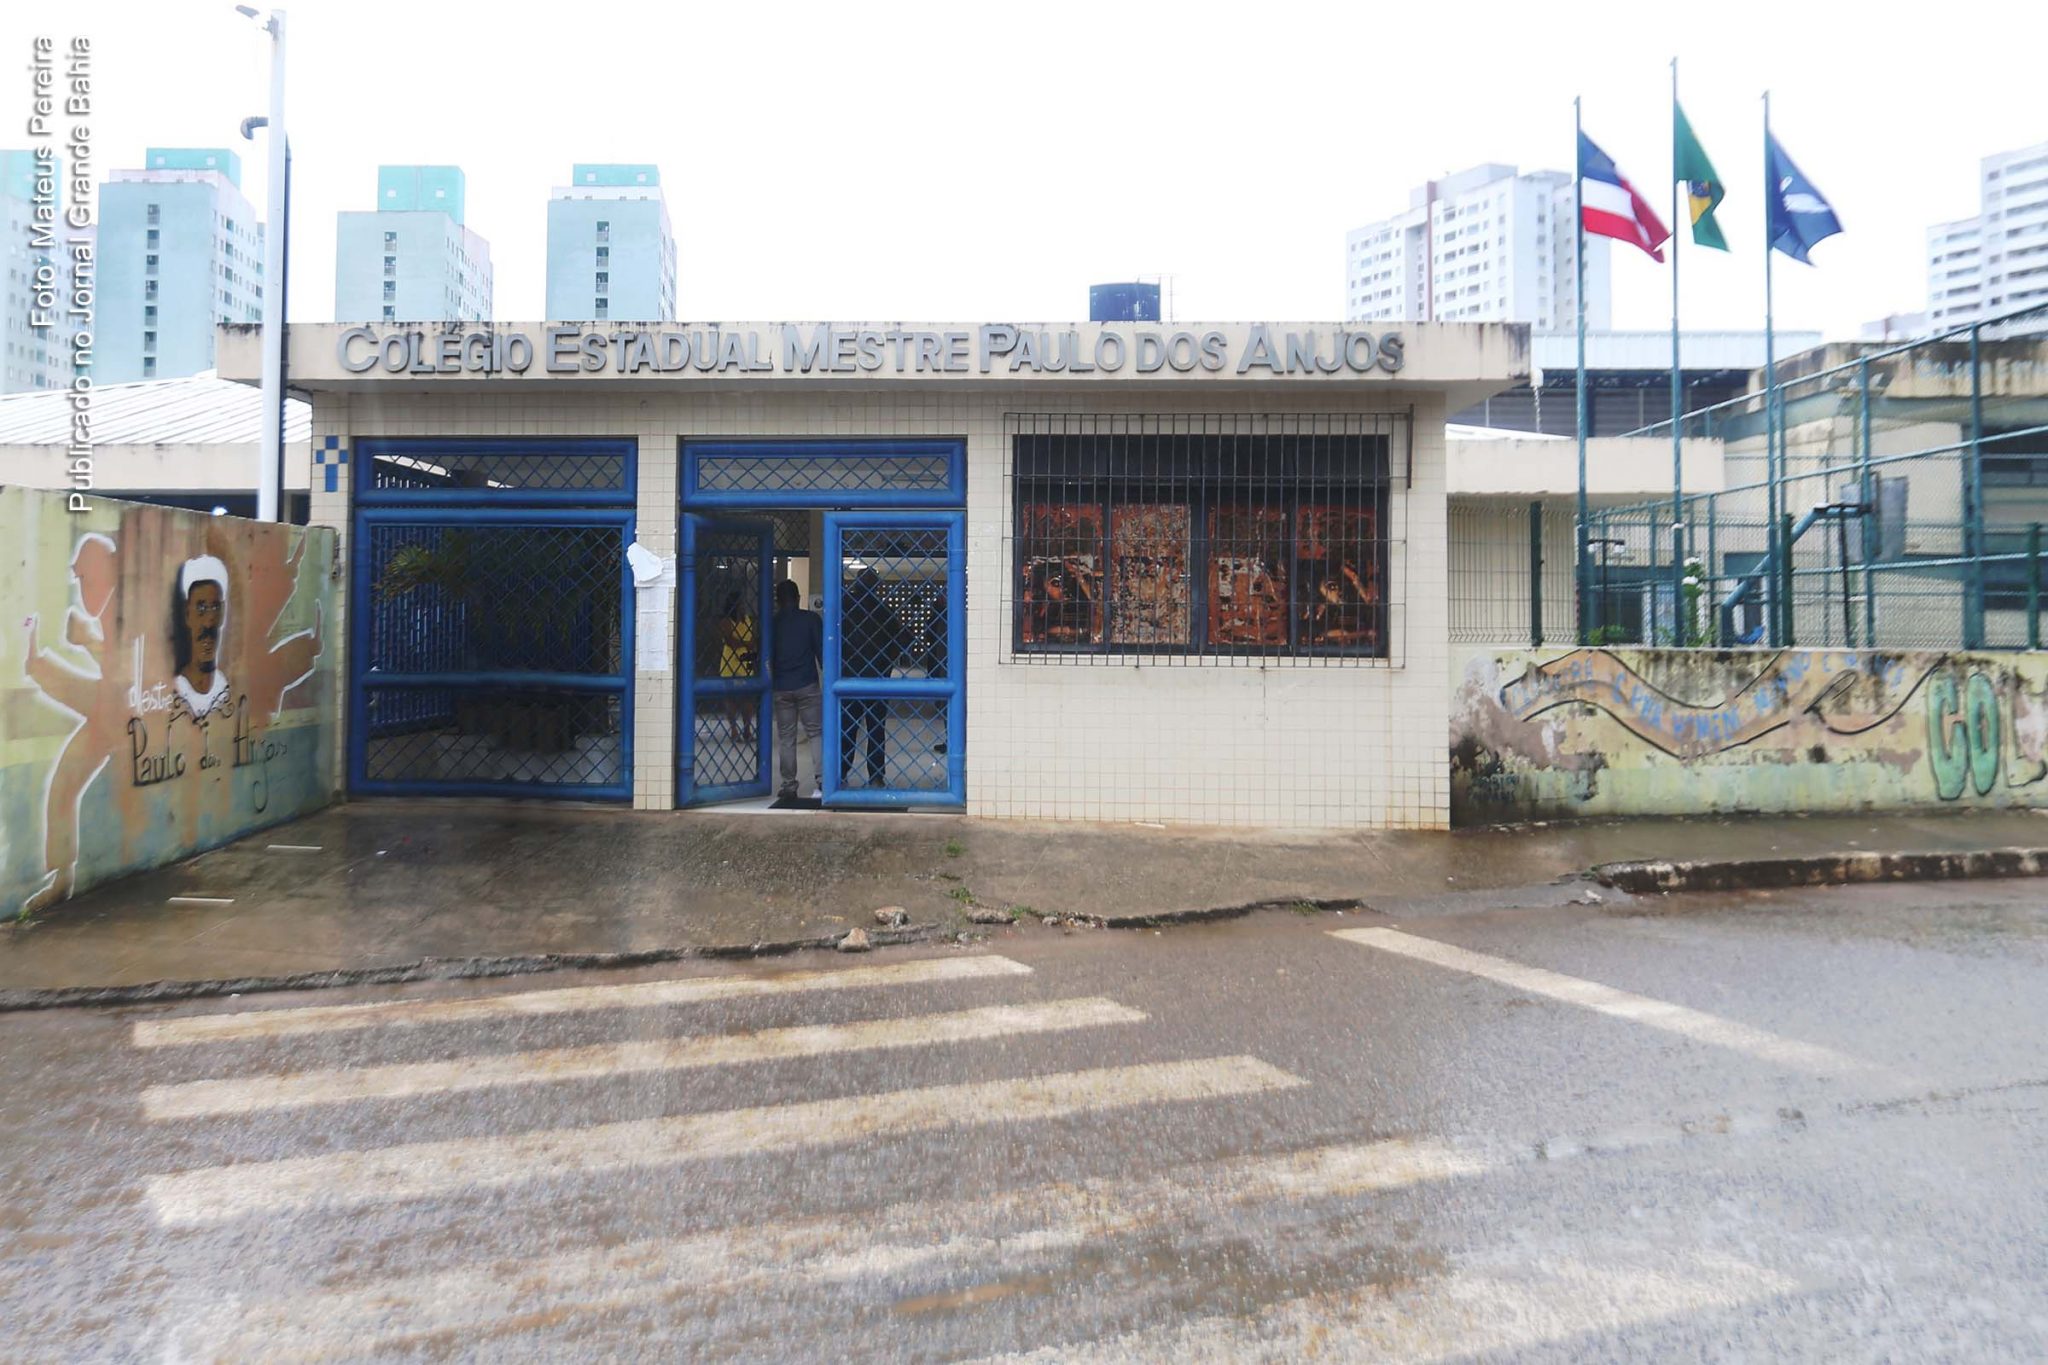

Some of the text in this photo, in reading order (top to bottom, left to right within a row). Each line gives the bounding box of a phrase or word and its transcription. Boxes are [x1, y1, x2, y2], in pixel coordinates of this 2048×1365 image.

[547, 327, 774, 373] ESTADUAL
[781, 325, 970, 373] MESTRE
[979, 324, 1126, 373] PAULO
[1136, 331, 1228, 372] DOS
[1237, 326, 1405, 373] ANJOS
[127, 716, 187, 788] Paulo
